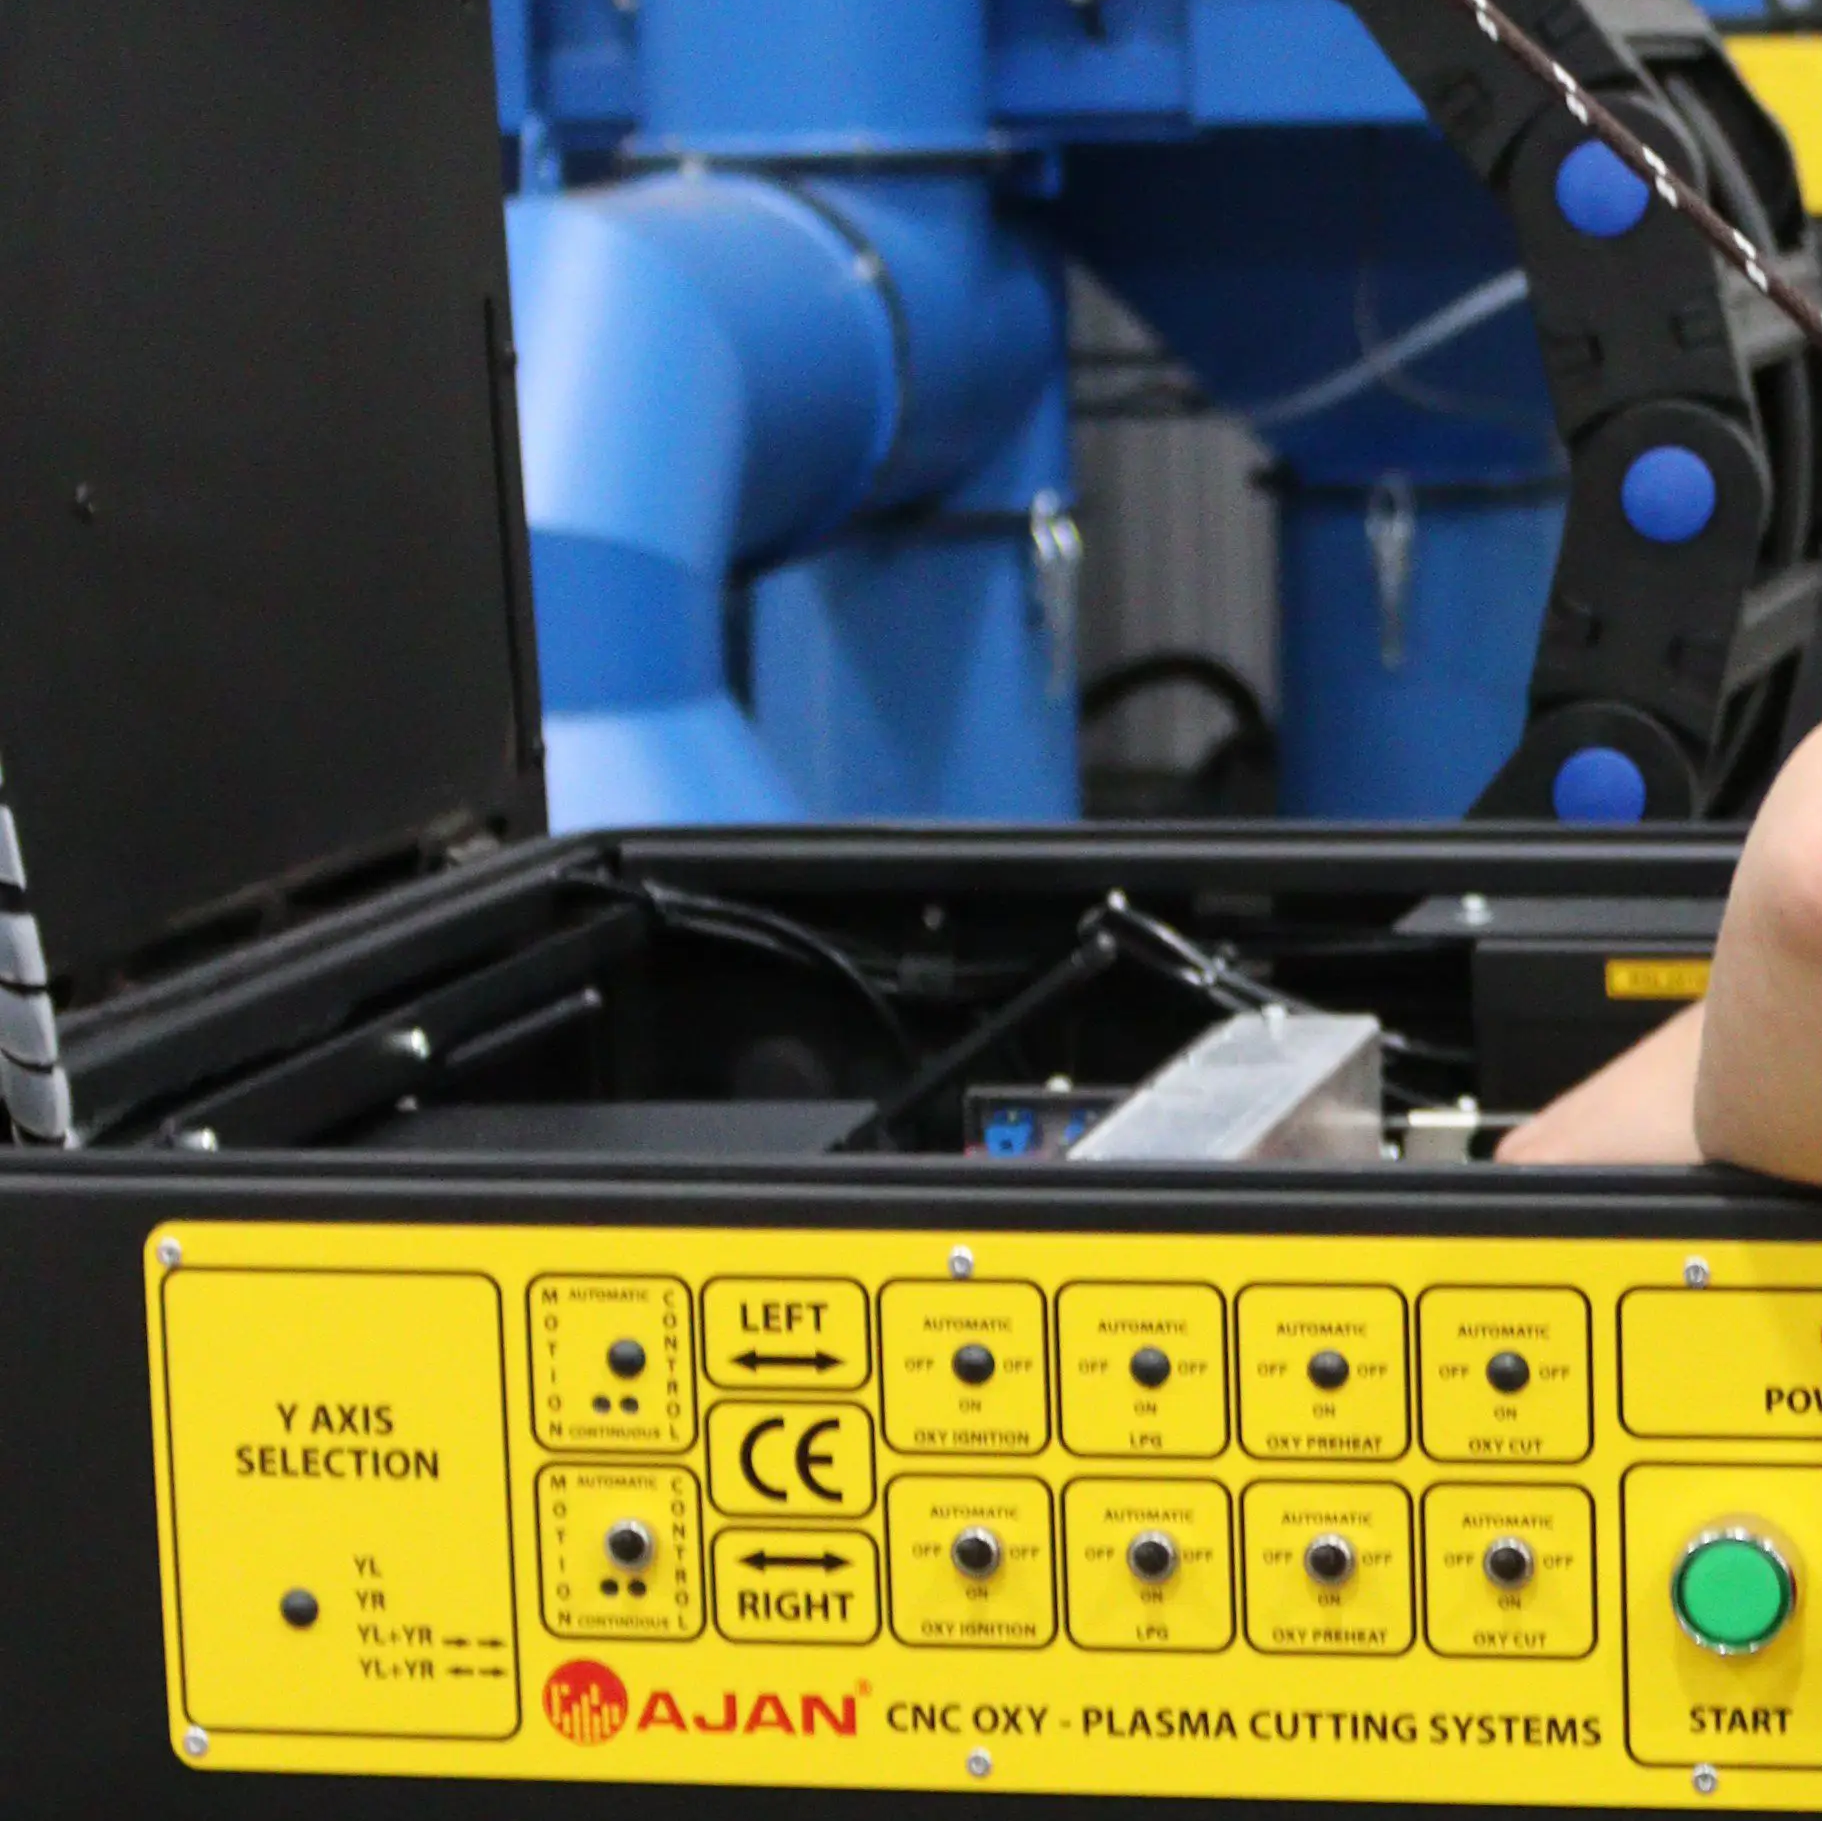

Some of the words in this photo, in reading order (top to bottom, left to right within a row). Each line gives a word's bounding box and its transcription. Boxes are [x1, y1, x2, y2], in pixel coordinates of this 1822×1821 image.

[741, 1303, 827, 1331] LEFT
[905, 1358, 934, 1371] OFF
[1003, 1359, 1032, 1372] OFF
[1078, 1360, 1108, 1372] OFF
[1177, 1361, 1207, 1374] OFF
[1257, 1363, 1287, 1376] OFF
[1357, 1364, 1387, 1377] OFF
[1439, 1365, 1469, 1378] OFF
[1539, 1366, 1569, 1379] OFF
[959, 1399, 982, 1412] ON
[1134, 1402, 1157, 1415] ON
[1313, 1404, 1336, 1417] ON
[277, 1404, 297, 1432] Y
[312, 1405, 393, 1435] AXIS
[1494, 1407, 1517, 1420] ON
[914, 1430, 947, 1444] OXY
[1130, 1434, 1162, 1448] LPG
[1266, 1436, 1301, 1449] OXY
[1307, 1437, 1381, 1451] PREHEAT
[1469, 1439, 1503, 1452] OXY
[1509, 1438, 1542, 1455] CUT
[236, 1446, 438, 1479] SELECTION
[912, 1545, 942, 1556] OFF
[1009, 1546, 1039, 1560] OFF
[1085, 1547, 1114, 1559] OFF
[1183, 1549, 1214, 1565] OFF
[1263, 1551, 1293, 1563] OFF
[1361, 1553, 1392, 1566] OFF
[355, 1558, 380, 1577] YL
[1444, 1553, 1474, 1565] OFF
[1542, 1555, 1573, 1570] OFF
[356, 1591, 385, 1609] YR
[966, 1586, 989, 1600] ON
[1141, 1589, 1164, 1604] ON
[1318, 1592, 1342, 1607] ON
[739, 1591, 853, 1620] RIGHT
[1499, 1595, 1522, 1610] ON
[358, 1625, 432, 1645] YL+YR
[921, 1621, 954, 1635] OXY
[1137, 1624, 1168, 1640] LPG
[1272, 1628, 1306, 1642] OXY
[1313, 1628, 1385, 1642] PREHEAT
[1473, 1632, 1508, 1645] OXY
[1513, 1632, 1546, 1647] CUT
[360, 1659, 434, 1678] YL+YR
[638, 1691, 856, 1735] AJAN
[1690, 1707, 1791, 1733] START
[887, 1704, 959, 1732] CNC
[973, 1706, 1047, 1733] OXY
[1083, 1708, 1237, 1738] PLASMA
[1250, 1712, 1417, 1741] CUTTING
[1430, 1716, 1601, 1745] SYSTEMS
